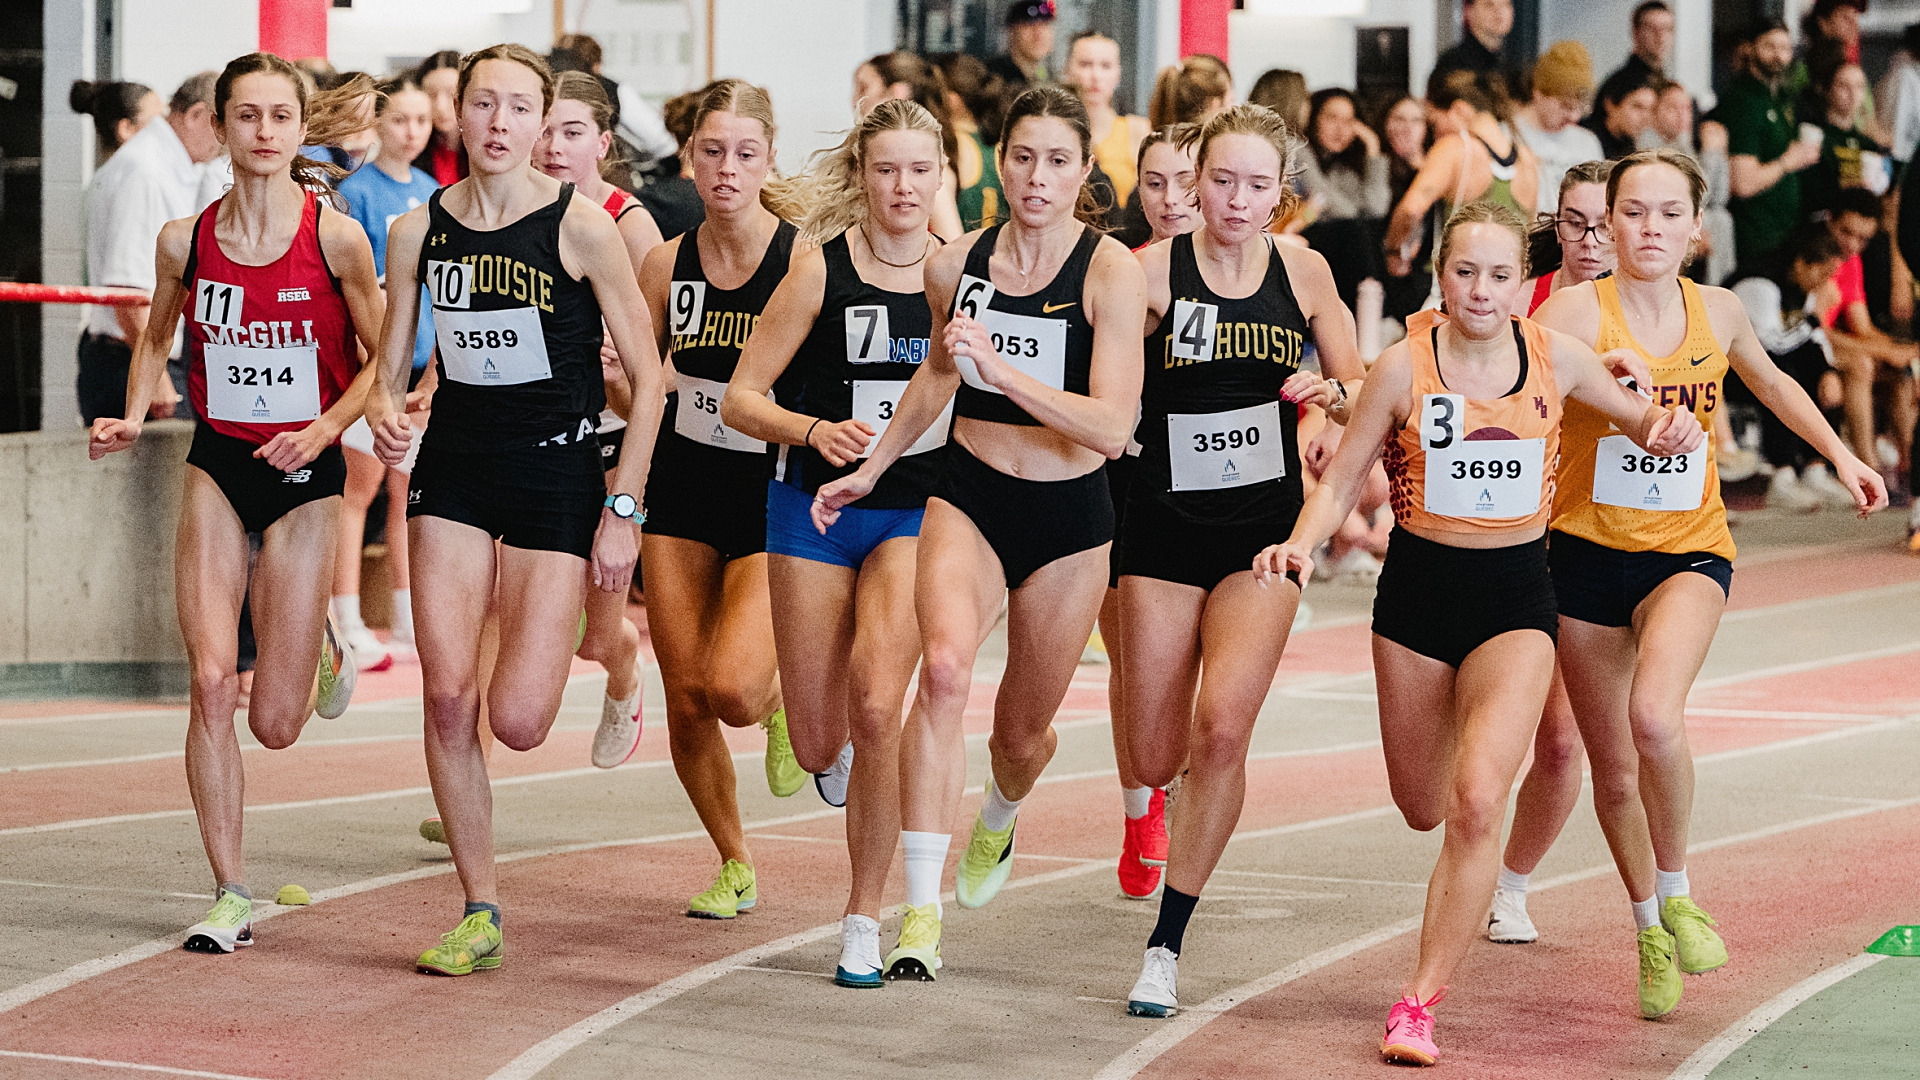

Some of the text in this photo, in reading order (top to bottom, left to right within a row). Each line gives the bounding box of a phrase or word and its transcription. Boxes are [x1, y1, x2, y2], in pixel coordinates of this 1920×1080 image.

[277, 290, 311, 302] RSEQ
[434, 264, 463, 305] 10
[203, 284, 232, 325] 11
[676, 284, 695, 332] 9
[960, 282, 986, 320] 6
[202, 320, 320, 349] MCGILL
[453, 329, 518, 349] 3589
[853, 309, 878, 359] 7
[991, 333, 1039, 358] 053
[1179, 306, 1207, 356] 4
[1164, 322, 1303, 370] DHOUSIE
[227, 366, 294, 386] 3214
[694, 391, 718, 415] 35
[1429, 397, 1454, 449] 3
[1193, 426, 1260, 453] 3590
[1451, 460, 1522, 480] 3699
[1622, 454, 1689, 475] 3623
